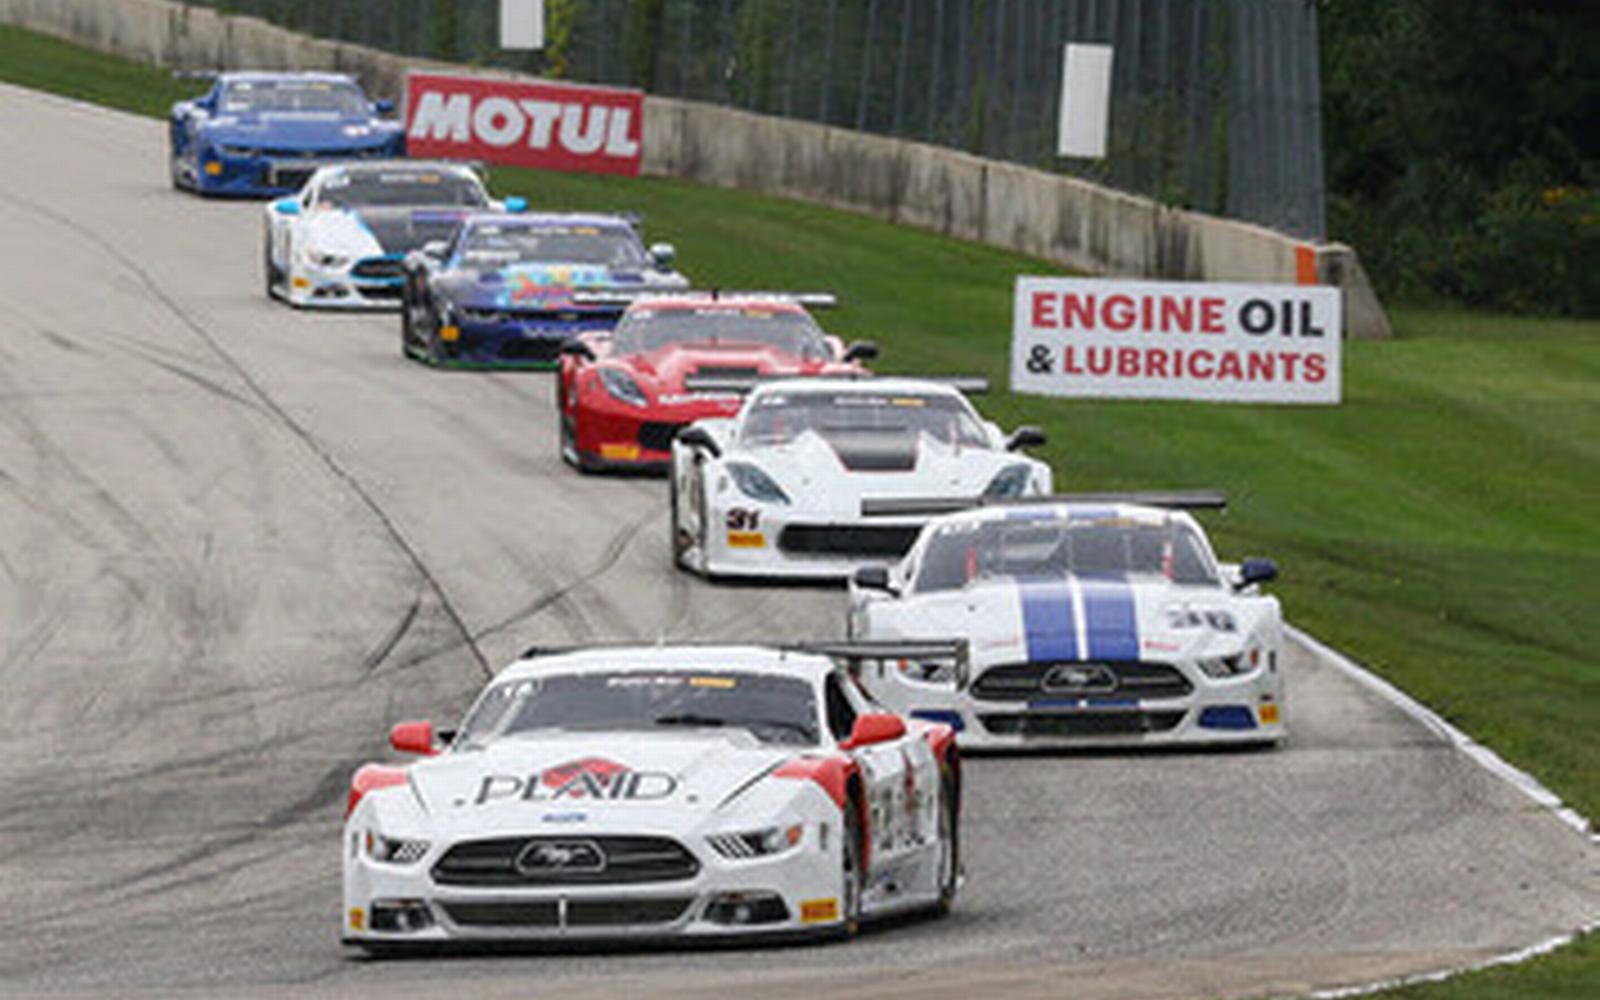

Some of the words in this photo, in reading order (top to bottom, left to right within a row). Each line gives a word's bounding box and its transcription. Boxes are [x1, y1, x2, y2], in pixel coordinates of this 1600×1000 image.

[409, 90, 638, 158] MOTUL
[1031, 291, 1226, 333] ENGINE
[1239, 299, 1324, 337] OIL
[1026, 345, 1053, 374] &
[1064, 346, 1327, 383] LUBRICANTS
[475, 771, 678, 805] PLAID
